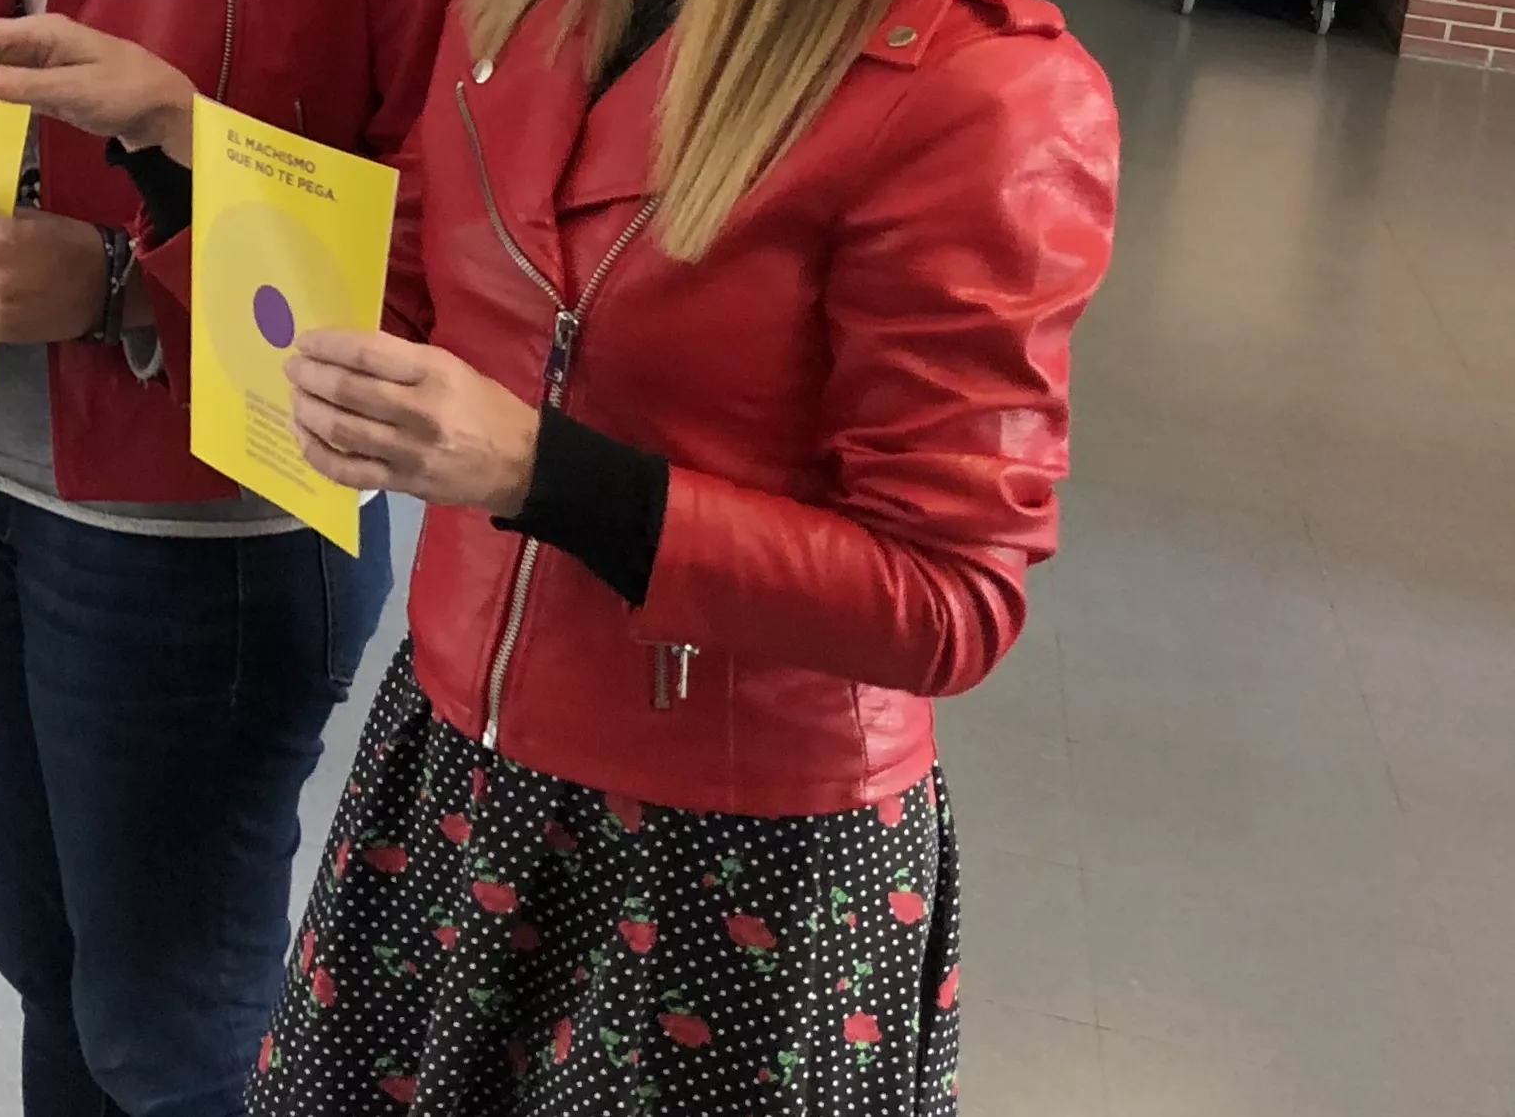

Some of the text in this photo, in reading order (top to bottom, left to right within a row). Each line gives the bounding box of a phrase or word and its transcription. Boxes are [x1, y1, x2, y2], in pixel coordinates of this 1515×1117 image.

[227, 128, 316, 174] EL MACHISMO
[227, 148, 252, 169] QUE
[255, 160, 274, 177] NO
[278, 169, 294, 186] TE
